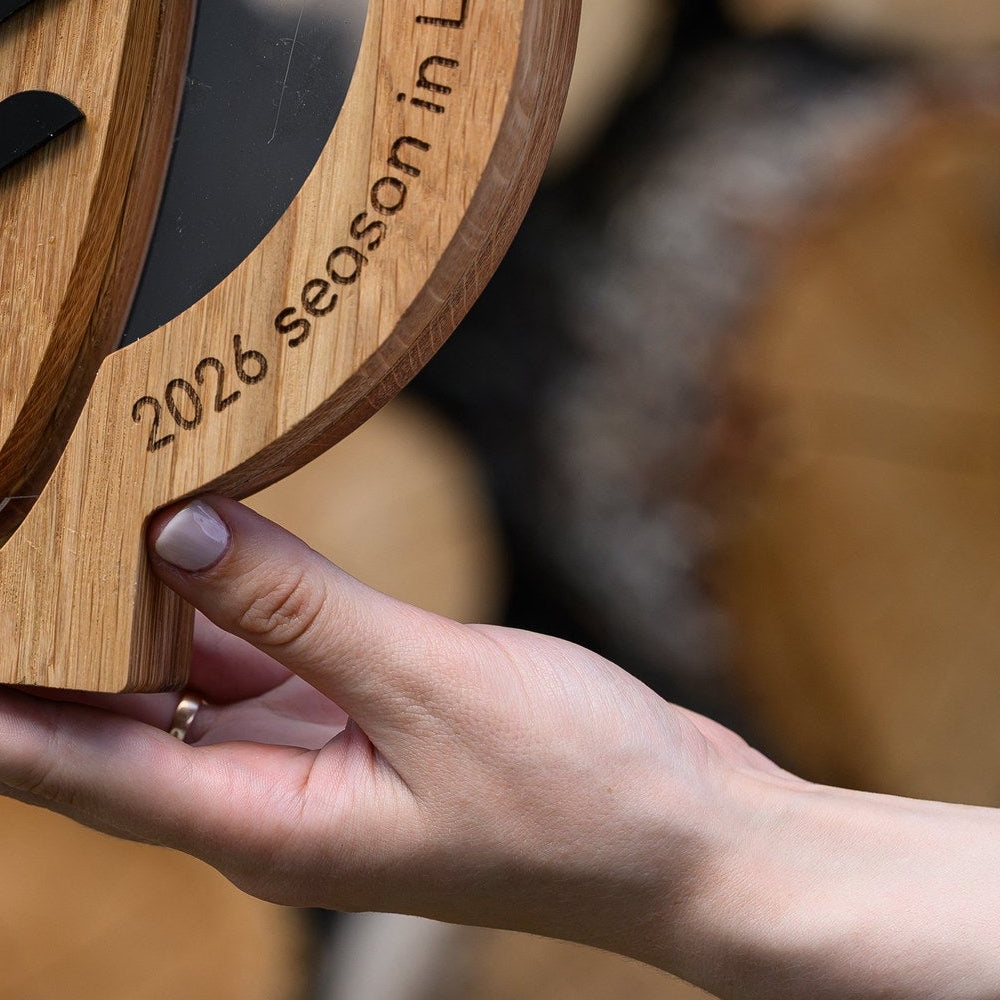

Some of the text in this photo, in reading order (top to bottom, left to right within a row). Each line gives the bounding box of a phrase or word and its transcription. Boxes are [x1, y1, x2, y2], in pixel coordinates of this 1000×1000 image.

[131, 333, 269, 452] 2026
[274, 135, 431, 348] season
[396, 54, 460, 115] in
